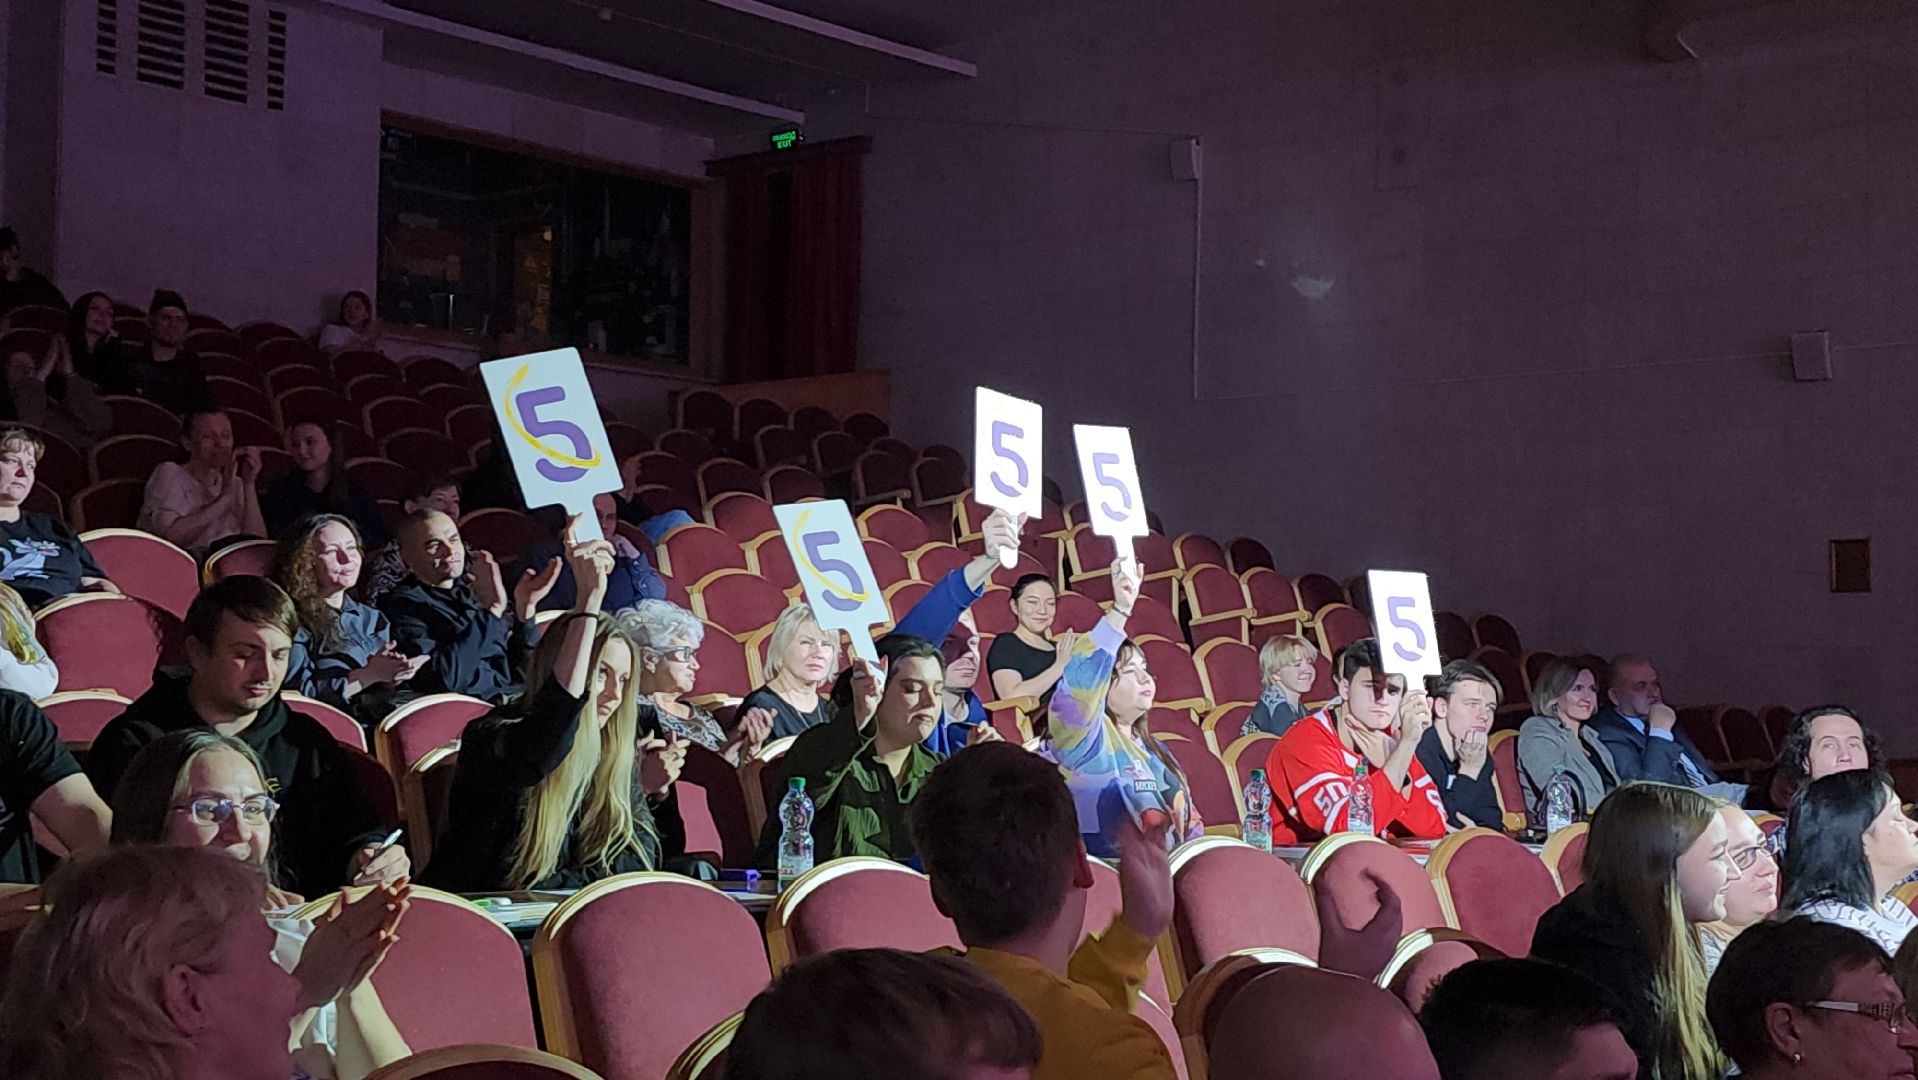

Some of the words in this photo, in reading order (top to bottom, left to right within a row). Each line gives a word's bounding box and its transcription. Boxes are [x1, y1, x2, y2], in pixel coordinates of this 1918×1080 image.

[515, 385, 593, 483] 5
[989, 419, 1029, 498] 5
[1092, 451, 1133, 522] 5
[802, 530, 865, 612] 5
[1387, 595, 1427, 662] 5
